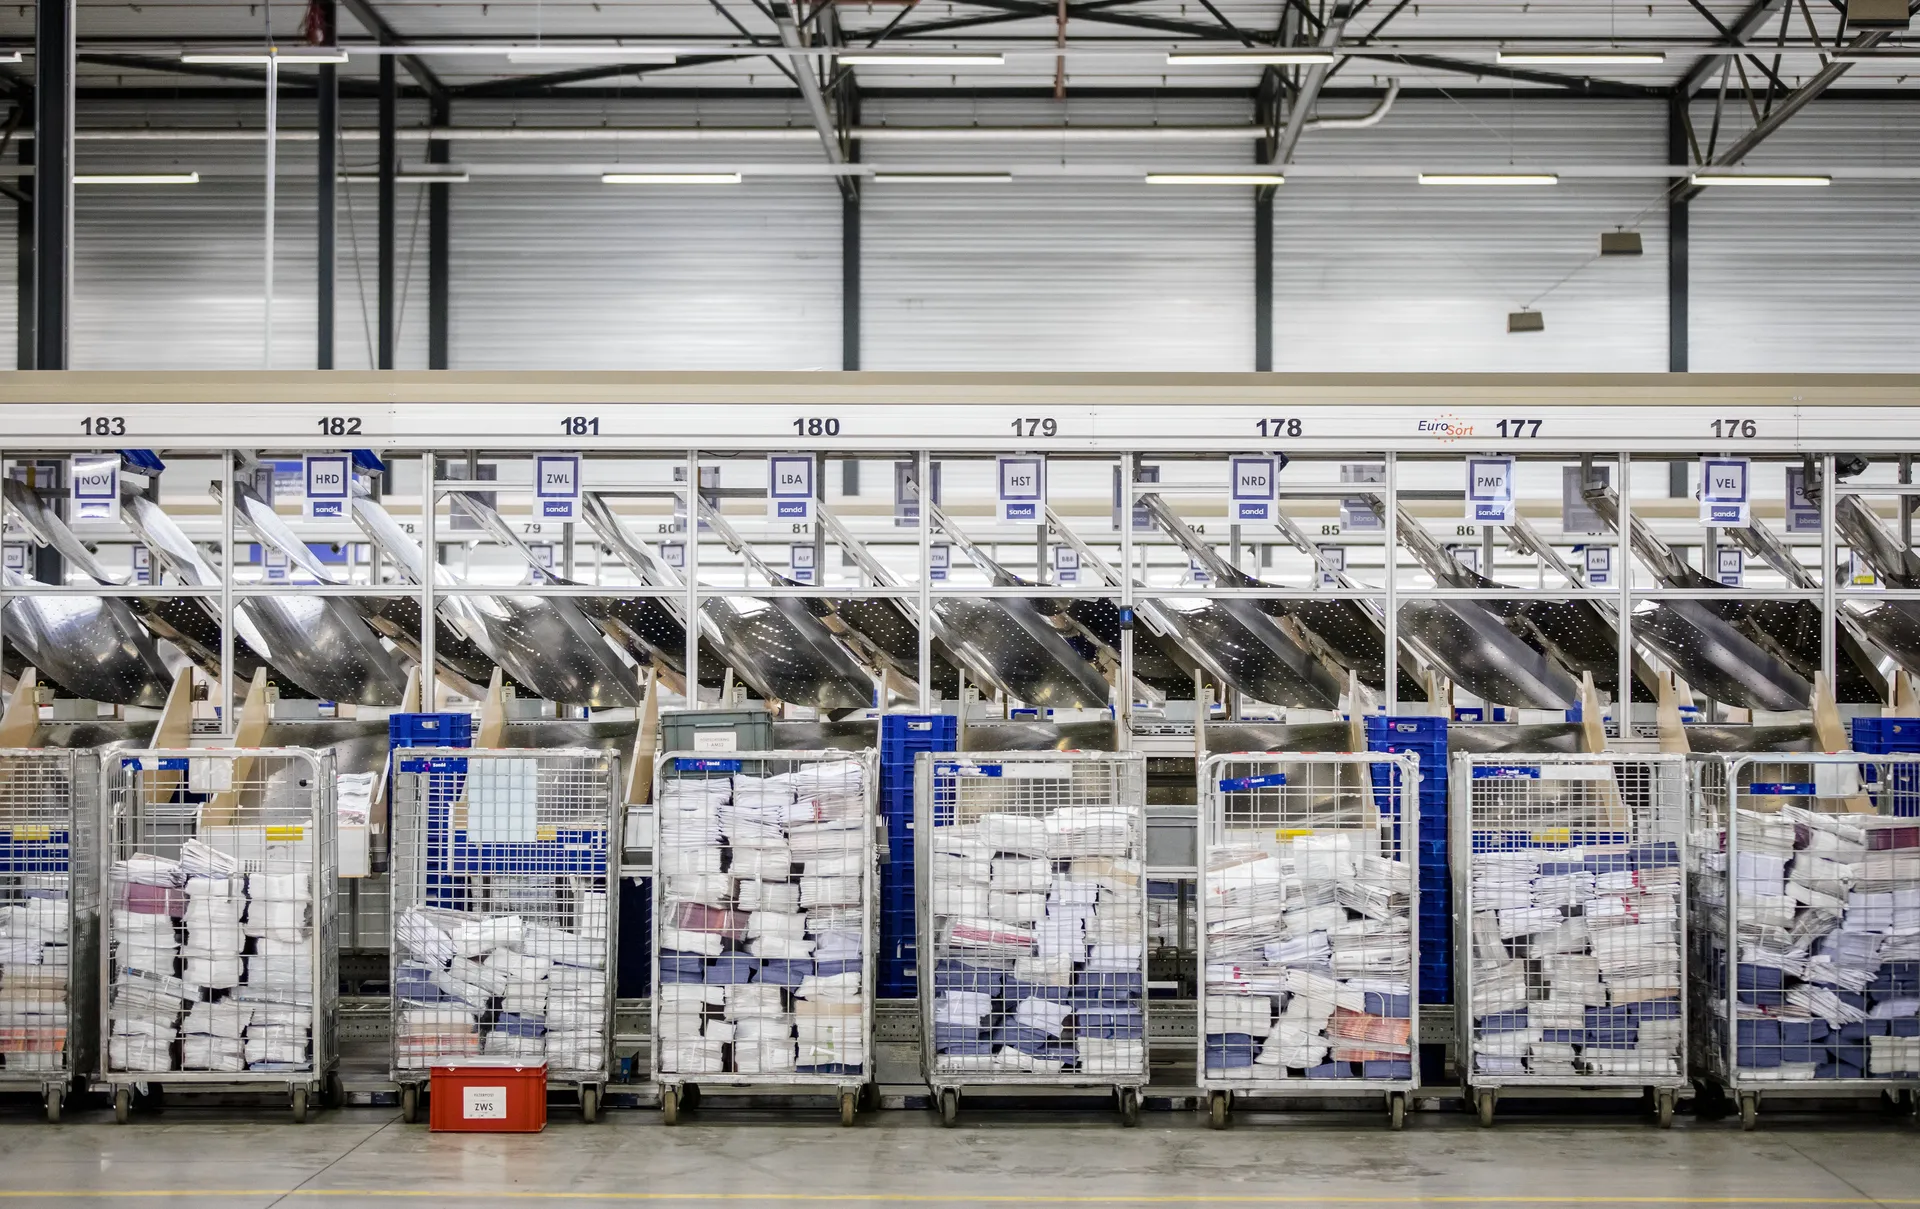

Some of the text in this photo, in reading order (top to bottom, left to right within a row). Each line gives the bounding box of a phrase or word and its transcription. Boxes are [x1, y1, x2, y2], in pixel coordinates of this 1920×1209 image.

[80, 417, 126, 435] 183
[317, 417, 362, 435] 182
[560, 416, 599, 435] 181
[793, 418, 840, 436] 180
[1011, 418, 1058, 437] 179
[1256, 418, 1303, 437] 178
[1496, 419, 1543, 438] 177
[1710, 419, 1757, 438] 176
[82, 475, 110, 485] NOV
[315, 474, 340, 484] HRD
[546, 473, 570, 484] ZWL
[781, 474, 803, 484] LBA
[1011, 476, 1031, 486] HST
[1241, 476, 1267, 486] NRD
[1477, 477, 1503, 487] PMD
[1715, 478, 1737, 489] VEL
[545, 505, 568, 513] sandd
[1713, 510, 1736, 518] sandd
[523, 523, 542, 533] 79
[658, 523, 675, 533] 80
[792, 523, 809, 534] 81
[1321, 525, 1340, 535] 85
[1456, 525, 1475, 536] 86
[474, 1102, 494, 1111] ZWS
